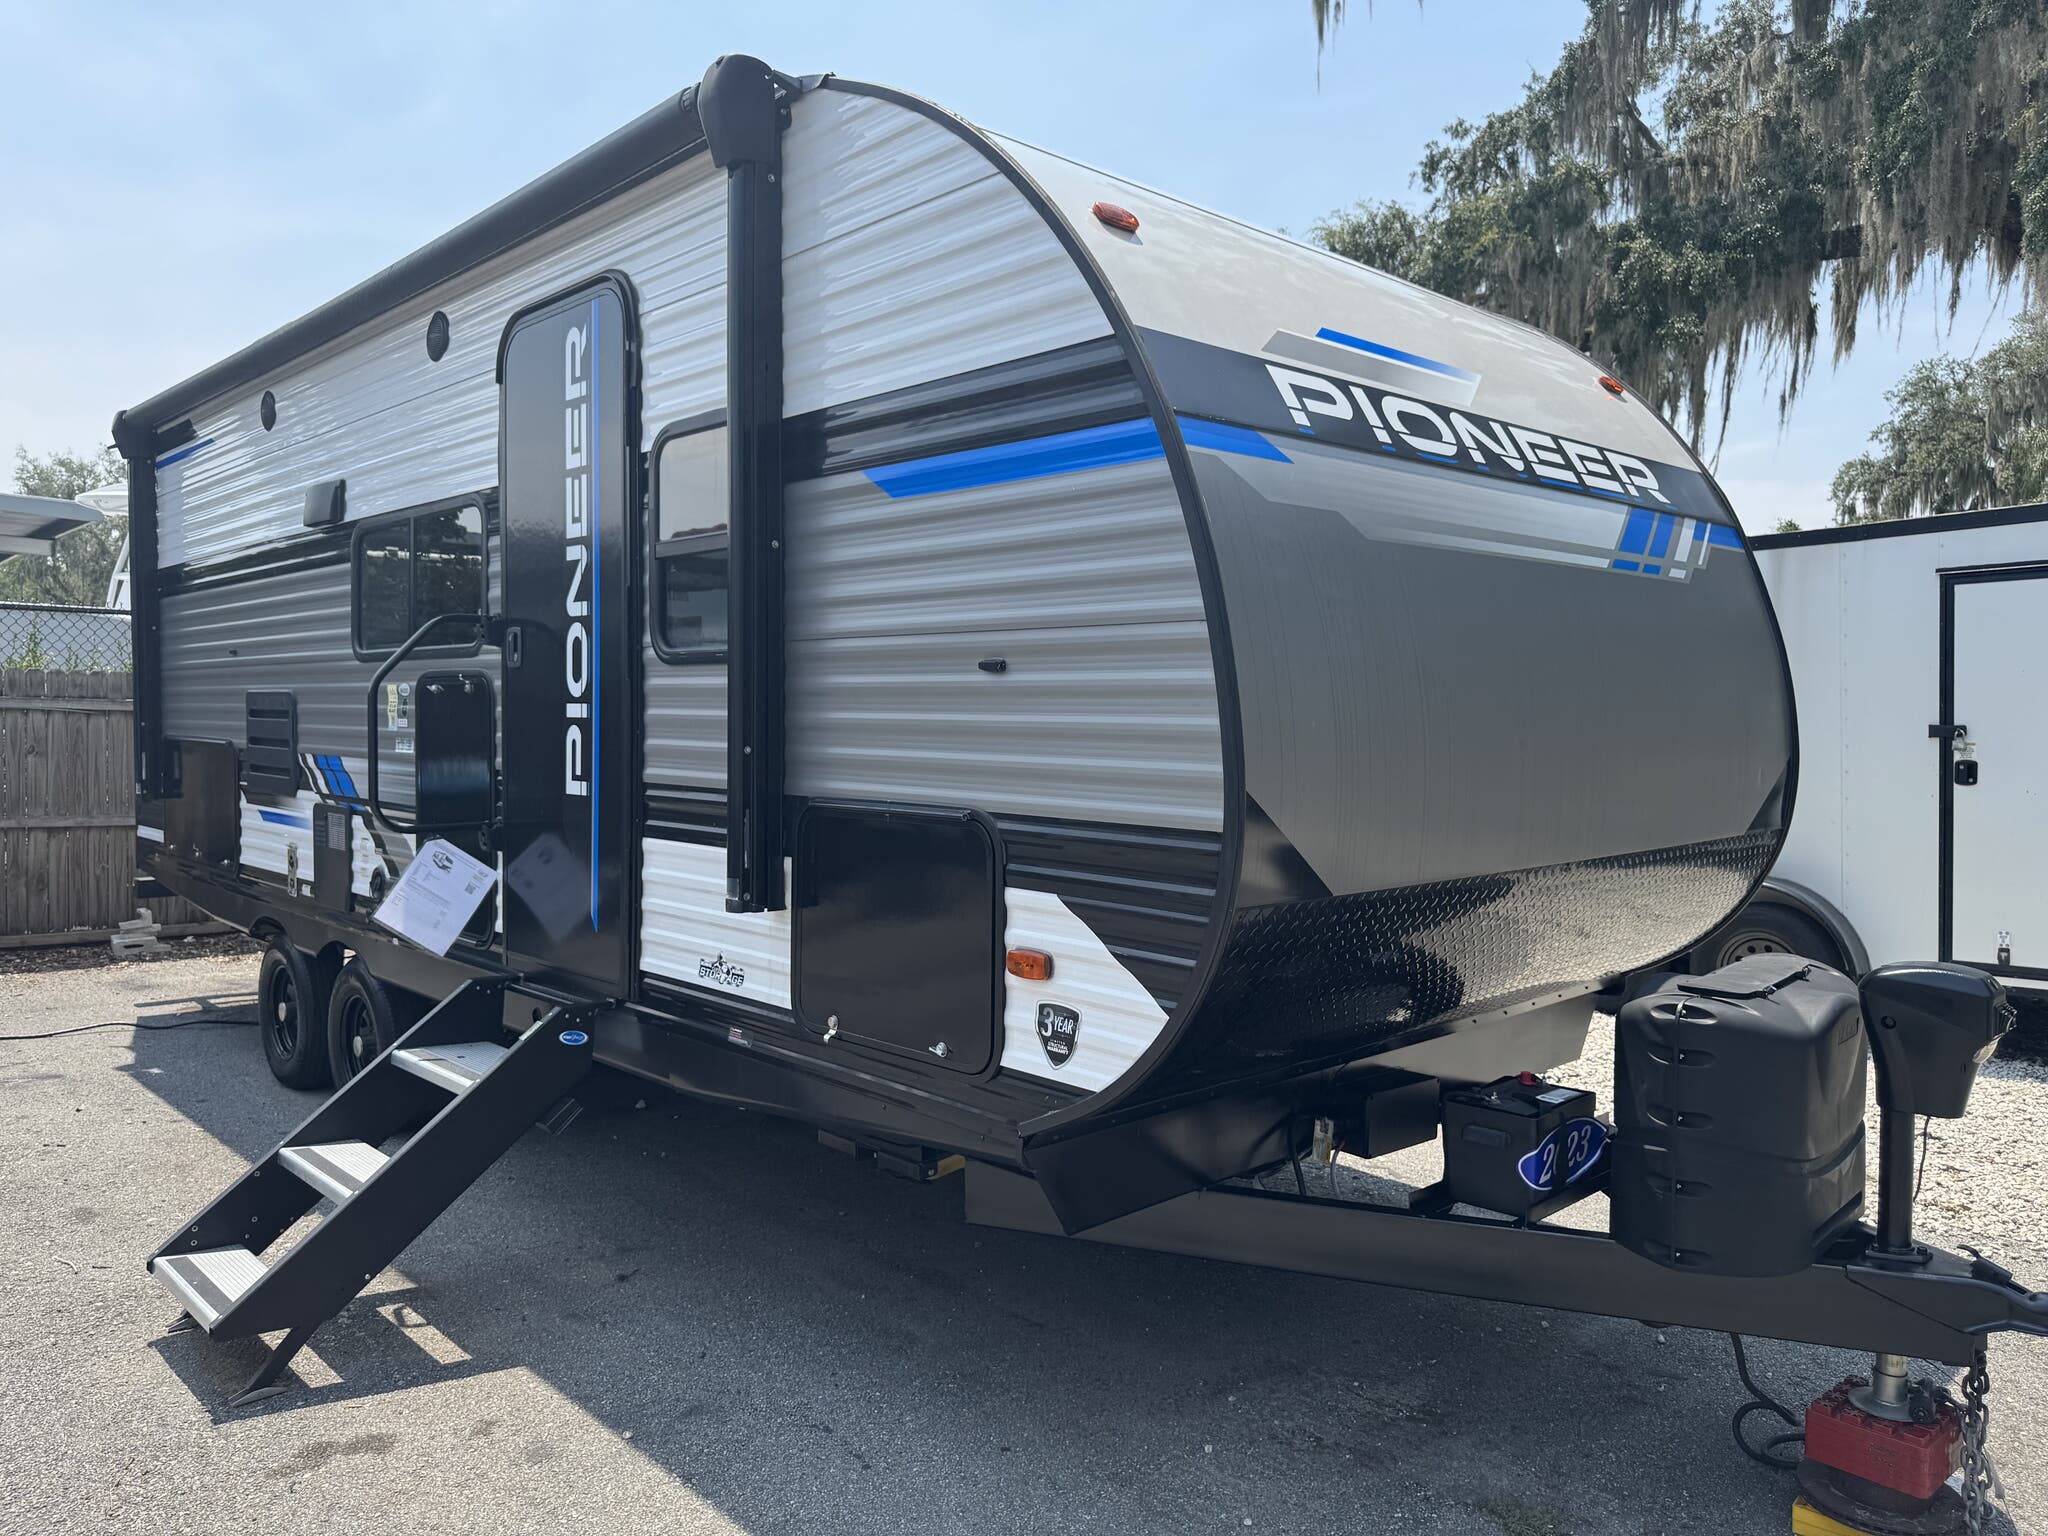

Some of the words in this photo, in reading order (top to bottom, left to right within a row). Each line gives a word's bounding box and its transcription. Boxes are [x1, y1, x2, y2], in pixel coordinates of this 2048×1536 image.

[1264, 364, 1672, 506] PIONEER
[565, 324, 590, 797] PIONEER
[699, 966, 744, 986] STORAGE
[1040, 1007, 1054, 1037] 3
[1053, 1015, 1074, 1035] YEAR
[1539, 1125, 1592, 1184] 223
